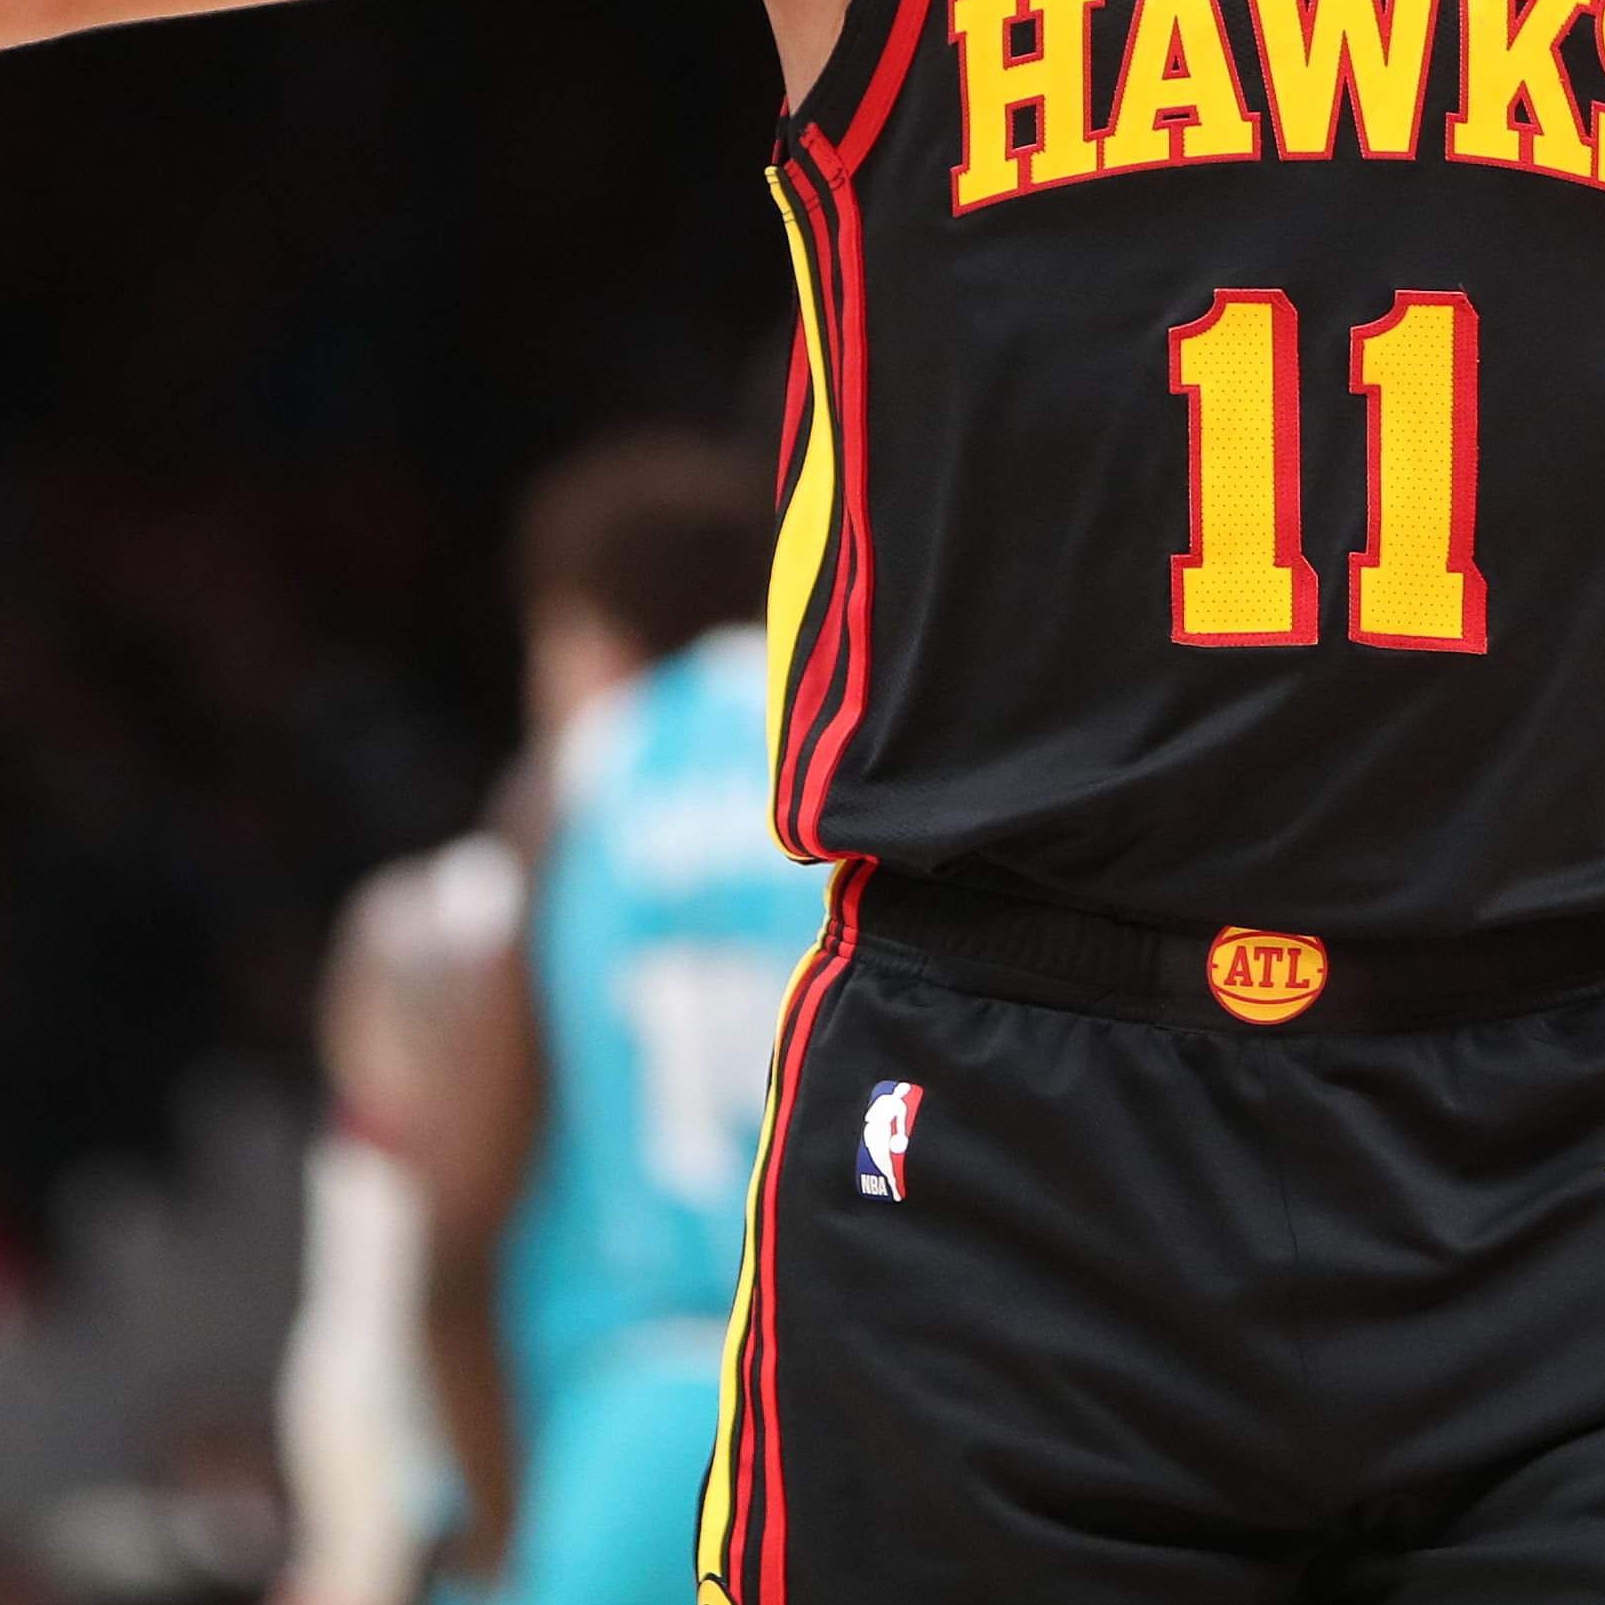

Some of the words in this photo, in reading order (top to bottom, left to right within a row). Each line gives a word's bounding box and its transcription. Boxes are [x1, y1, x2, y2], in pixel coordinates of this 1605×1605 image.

[1168, 288, 1488, 654] 11
[1223, 945, 1311, 989] ATL
[860, 1173, 889, 1197] NBA
